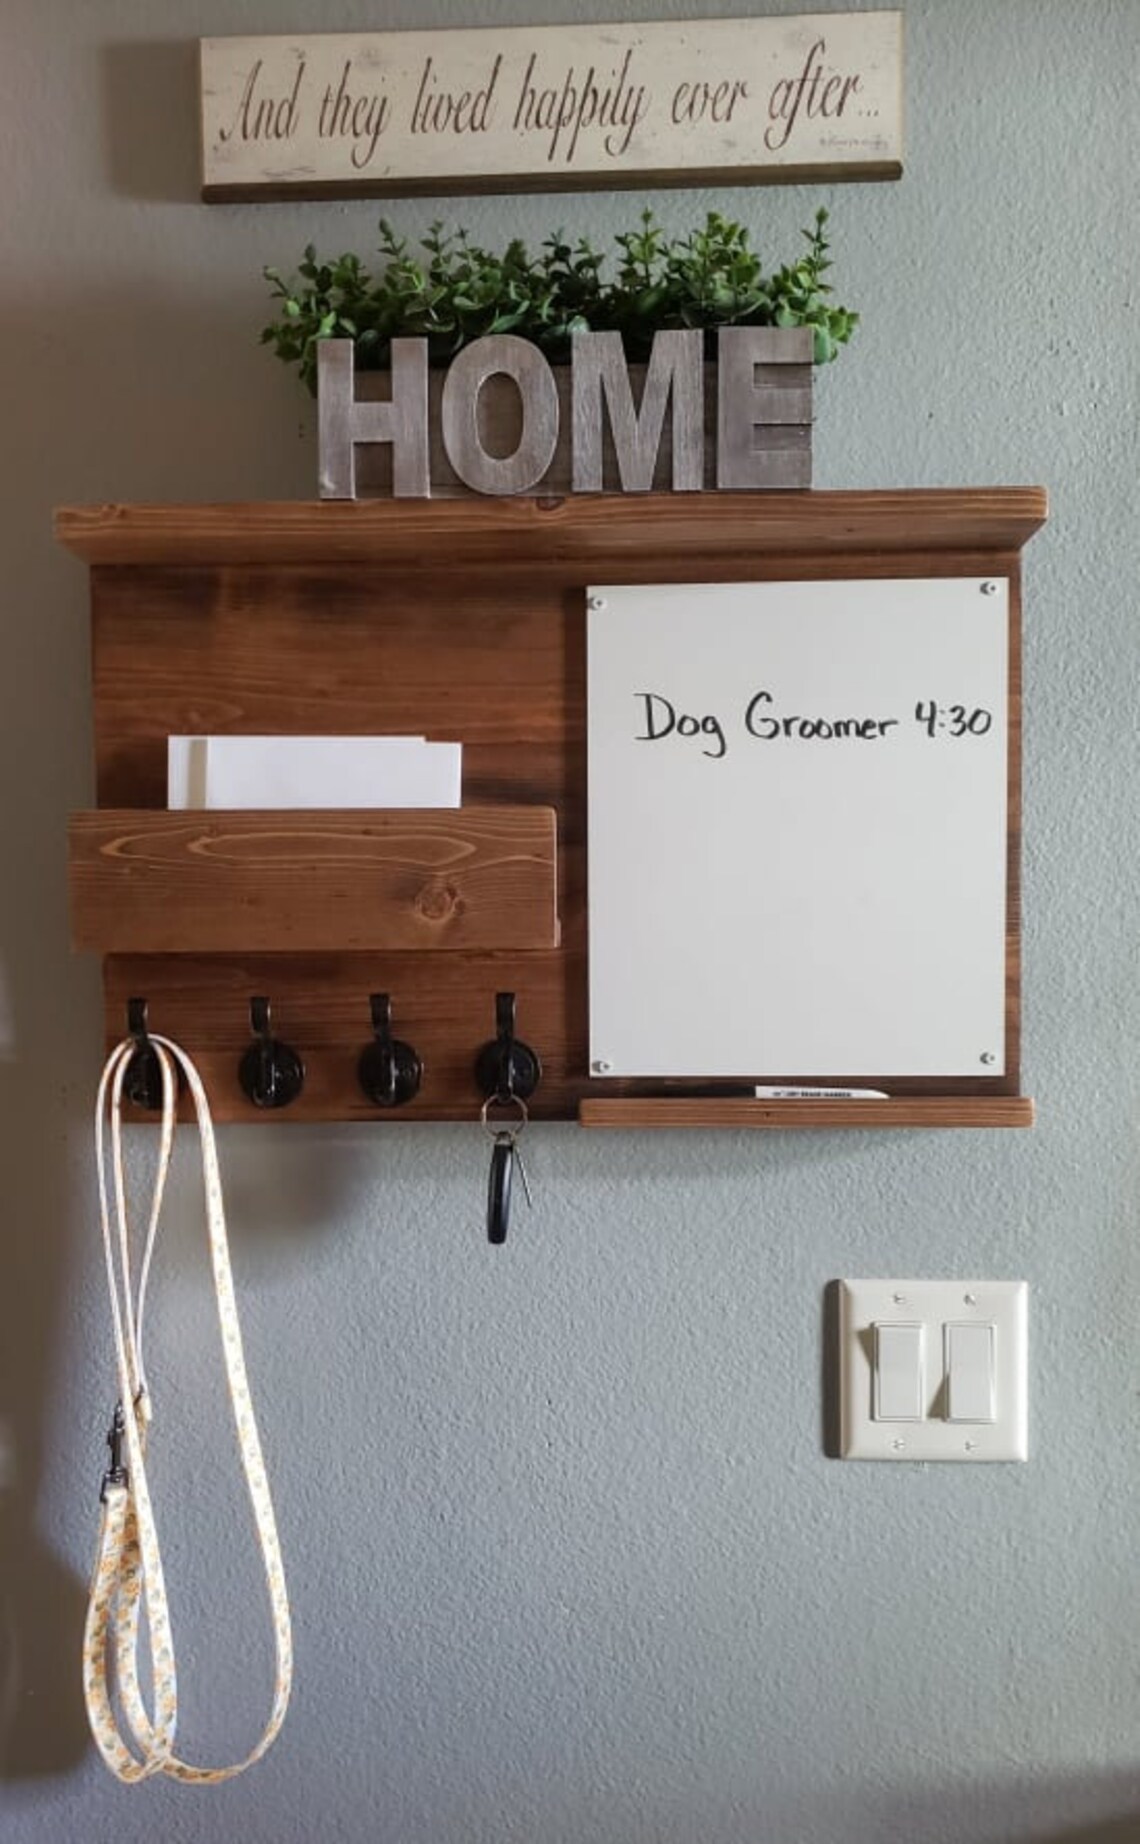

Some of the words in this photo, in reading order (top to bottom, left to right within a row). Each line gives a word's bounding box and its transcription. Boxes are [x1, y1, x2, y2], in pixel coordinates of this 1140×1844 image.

[219, 59, 306, 143] And
[317, 60, 390, 170] they
[411, 54, 503, 134] lived
[513, 49, 647, 162] happily
[671, 77, 750, 125] ever
[317, 326, 814, 499] HOME
[633, 692, 727, 758] Dog
[744, 690, 900, 740] Groomer
[914, 699, 993, 738] 4:30
